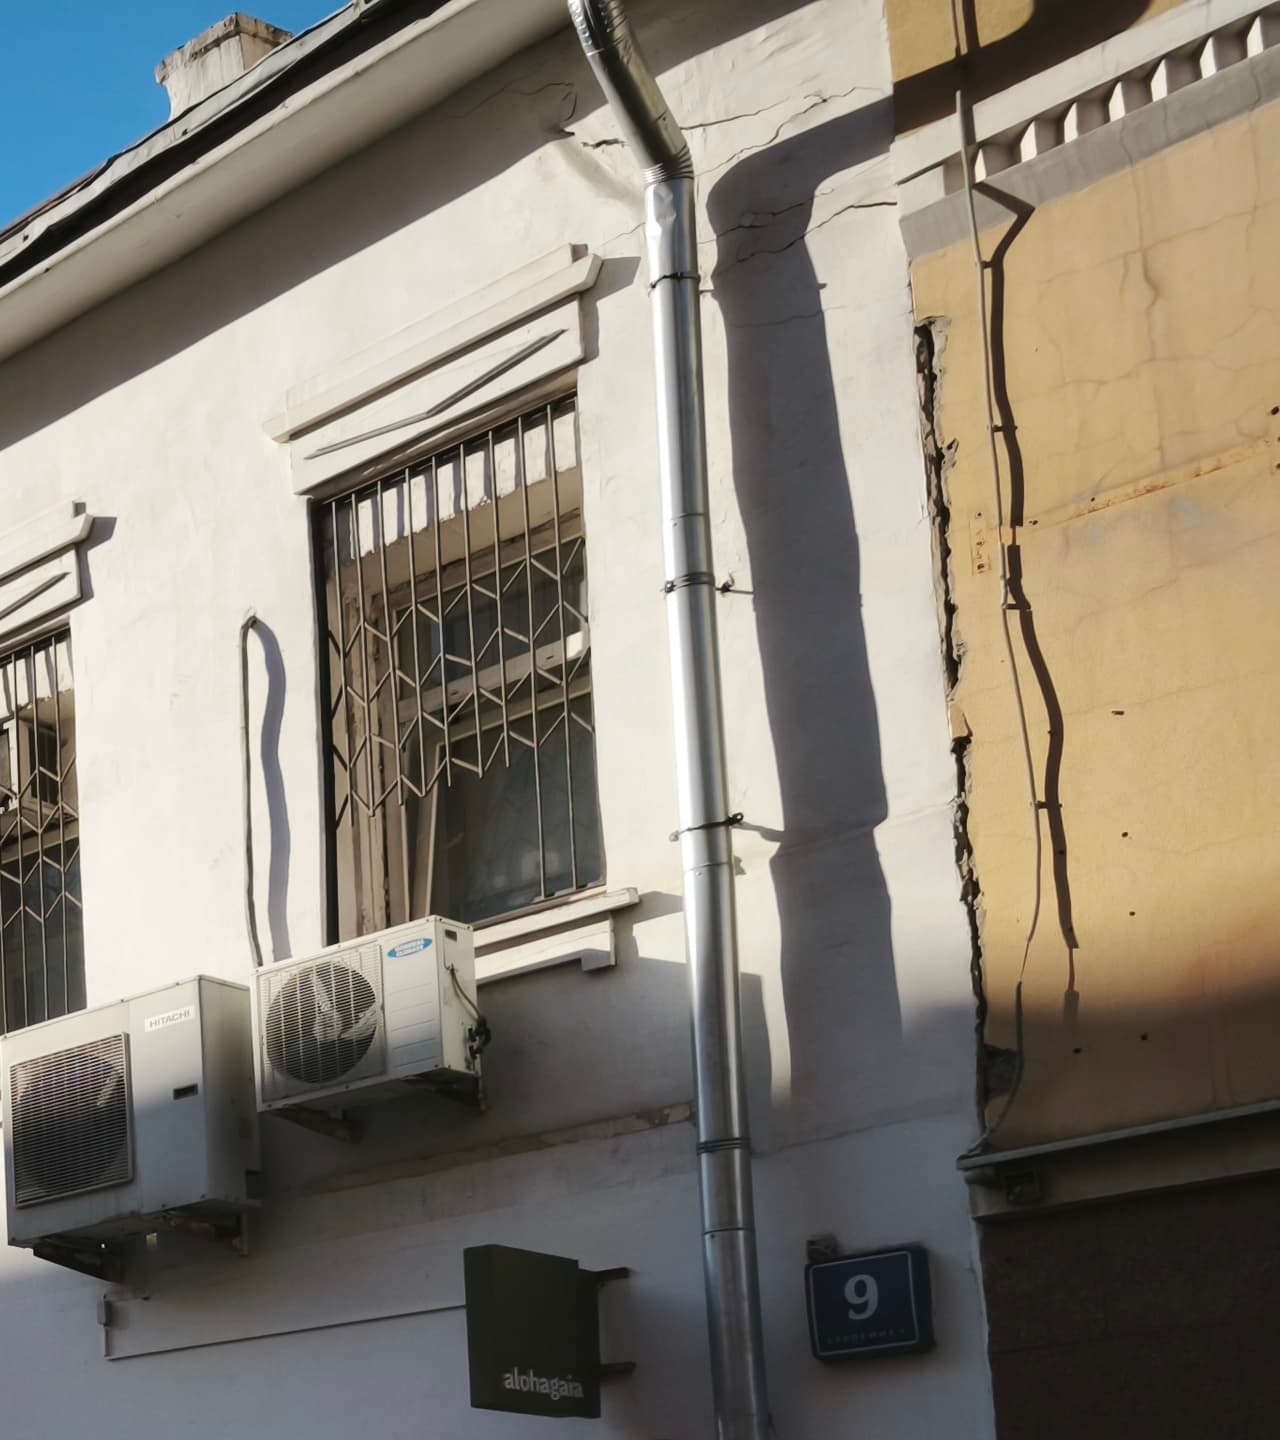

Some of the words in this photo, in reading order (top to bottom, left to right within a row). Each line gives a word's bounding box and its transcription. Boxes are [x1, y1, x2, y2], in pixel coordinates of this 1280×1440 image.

[150, 1009, 190, 1028] HITACHI
[844, 1273, 879, 1321] 9
[503, 1366, 584, 1401] alohagaia
